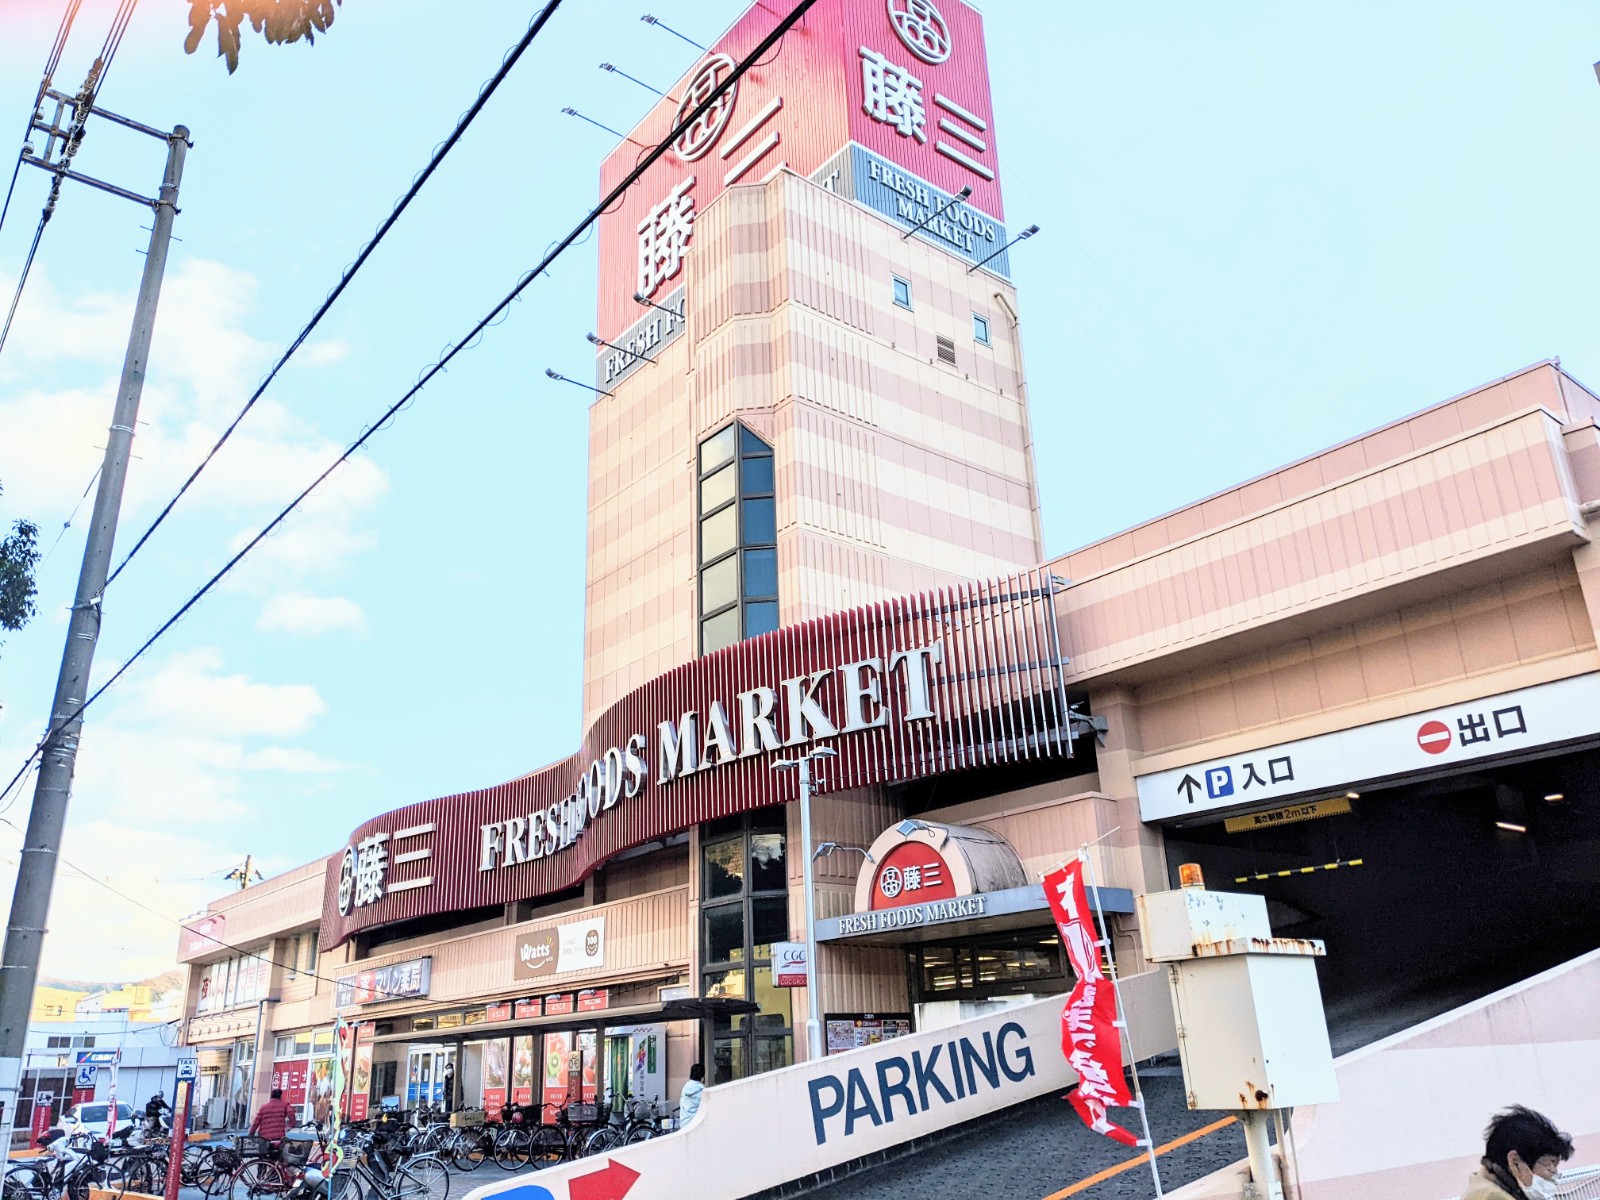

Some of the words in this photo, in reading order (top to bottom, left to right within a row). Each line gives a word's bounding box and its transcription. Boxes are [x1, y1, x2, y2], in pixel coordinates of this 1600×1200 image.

[859, 45, 994, 181] 藤三
[868, 160, 929, 208] FRESH
[934, 195, 996, 242] FOODS
[896, 196, 973, 253] MARKET
[604, 318, 661, 384] FRESH
[1457, 705, 1528, 747] 出口
[479, 794, 577, 872] FRESH
[657, 641, 942, 785] MARKET
[1242, 755, 1295, 791] 入口
[353, 822, 437, 908] 藤三
[902, 862, 944, 891] 藤三
[838, 914, 877, 934] FRESH
[880, 906, 923, 928] FOODS
[926, 896, 986, 921] MARKET
[520, 943, 550, 962] Watts
[783, 950, 807, 961] CGC
[808, 1020, 1036, 1146] PARKING
